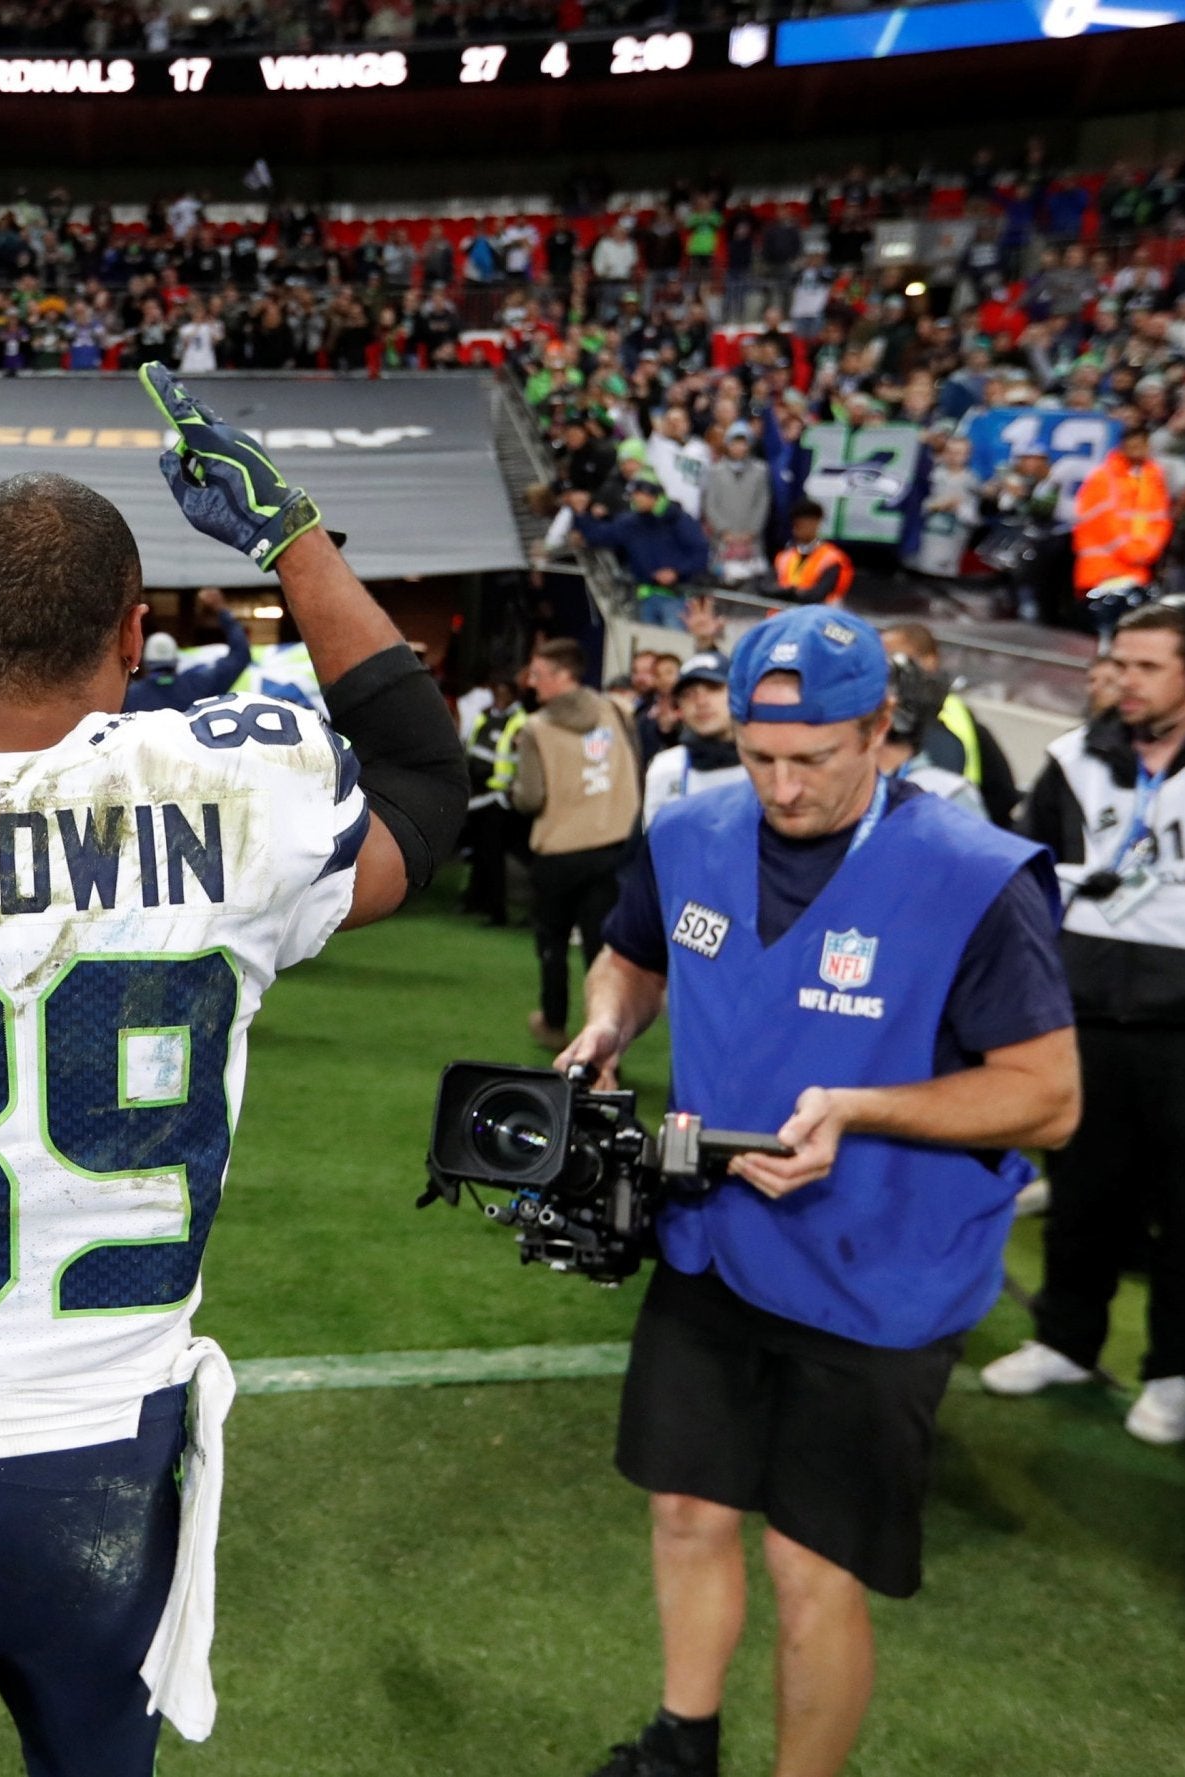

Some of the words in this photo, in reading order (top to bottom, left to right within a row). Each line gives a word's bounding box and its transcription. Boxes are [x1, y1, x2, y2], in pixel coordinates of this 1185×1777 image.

[168, 57, 212, 92] 17
[259, 51, 407, 90] VIKINGS
[459, 45, 506, 83] 27
[540, 41, 570, 78] 4
[800, 423, 919, 544] 12
[678, 911, 723, 948] SDS
[828, 953, 863, 982] NFL
[798, 987, 827, 1012] NFL
[828, 991, 885, 1019] FILMS
